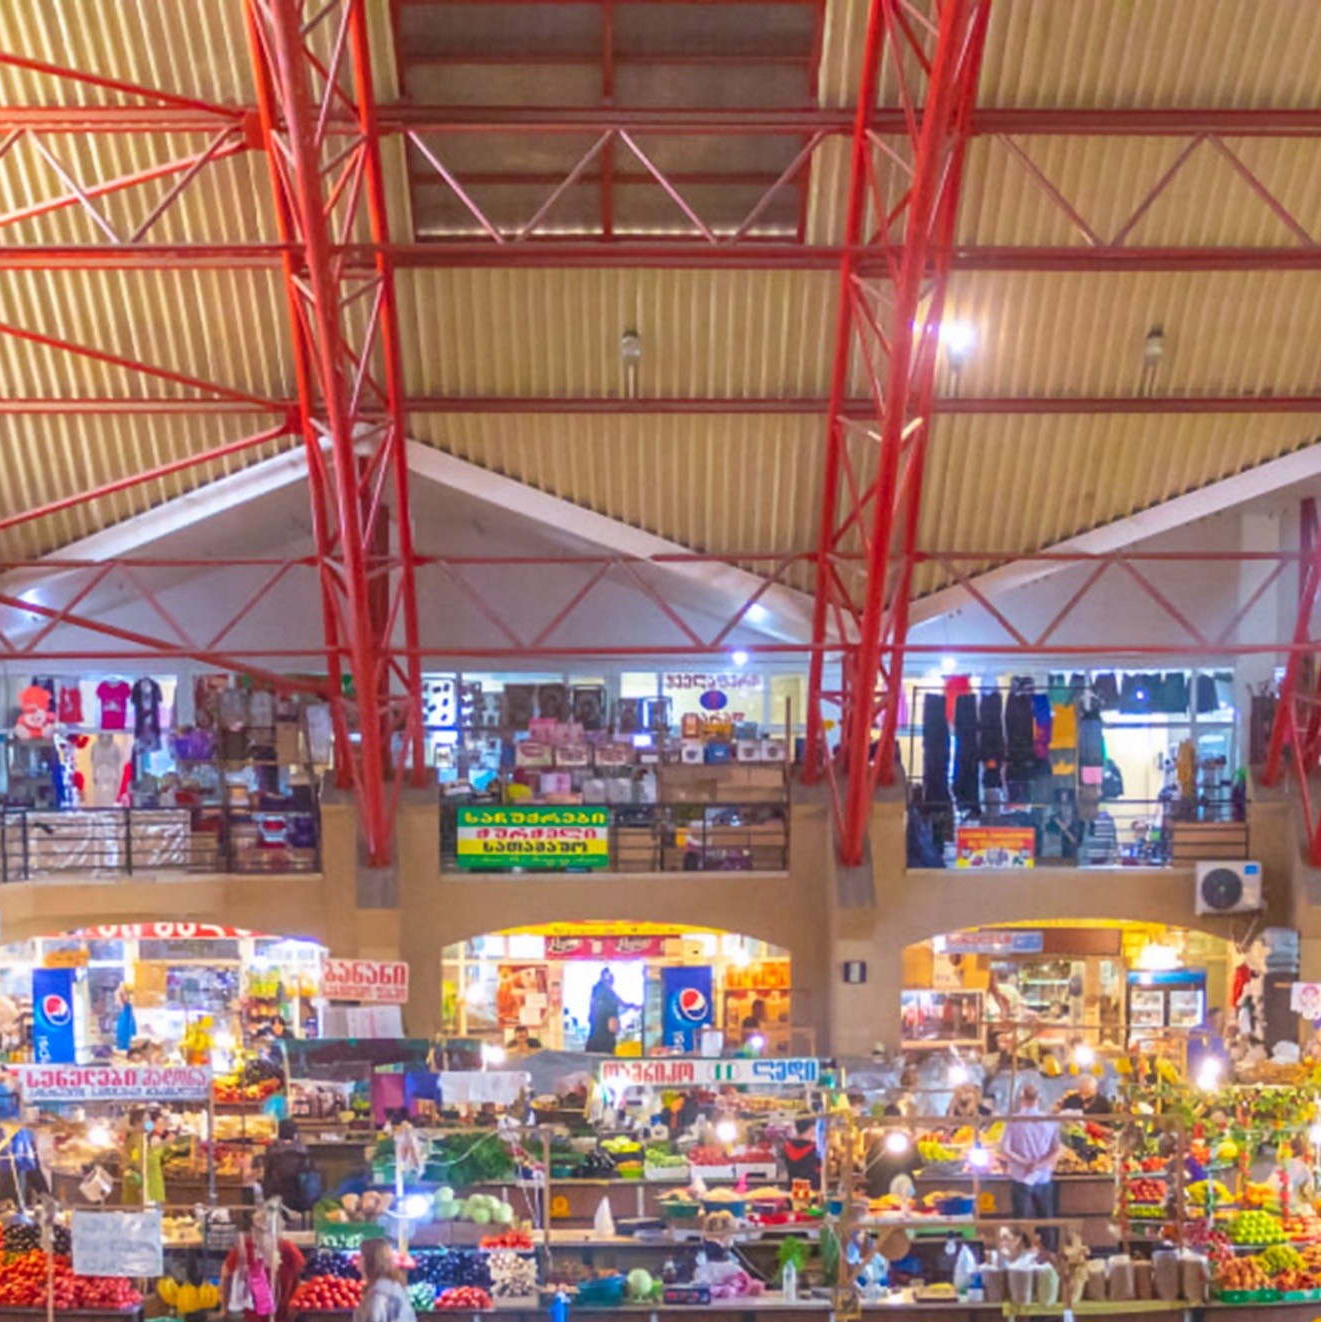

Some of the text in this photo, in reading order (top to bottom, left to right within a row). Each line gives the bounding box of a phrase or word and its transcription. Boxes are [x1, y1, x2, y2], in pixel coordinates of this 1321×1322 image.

[464, 811, 606, 824] საჩუქრები
[475, 827, 598, 840] ჭურჭელი
[483, 841, 588, 853] სათამაშო
[324, 962, 406, 985] ბანანი
[26, 1069, 138, 1088] სუნელები
